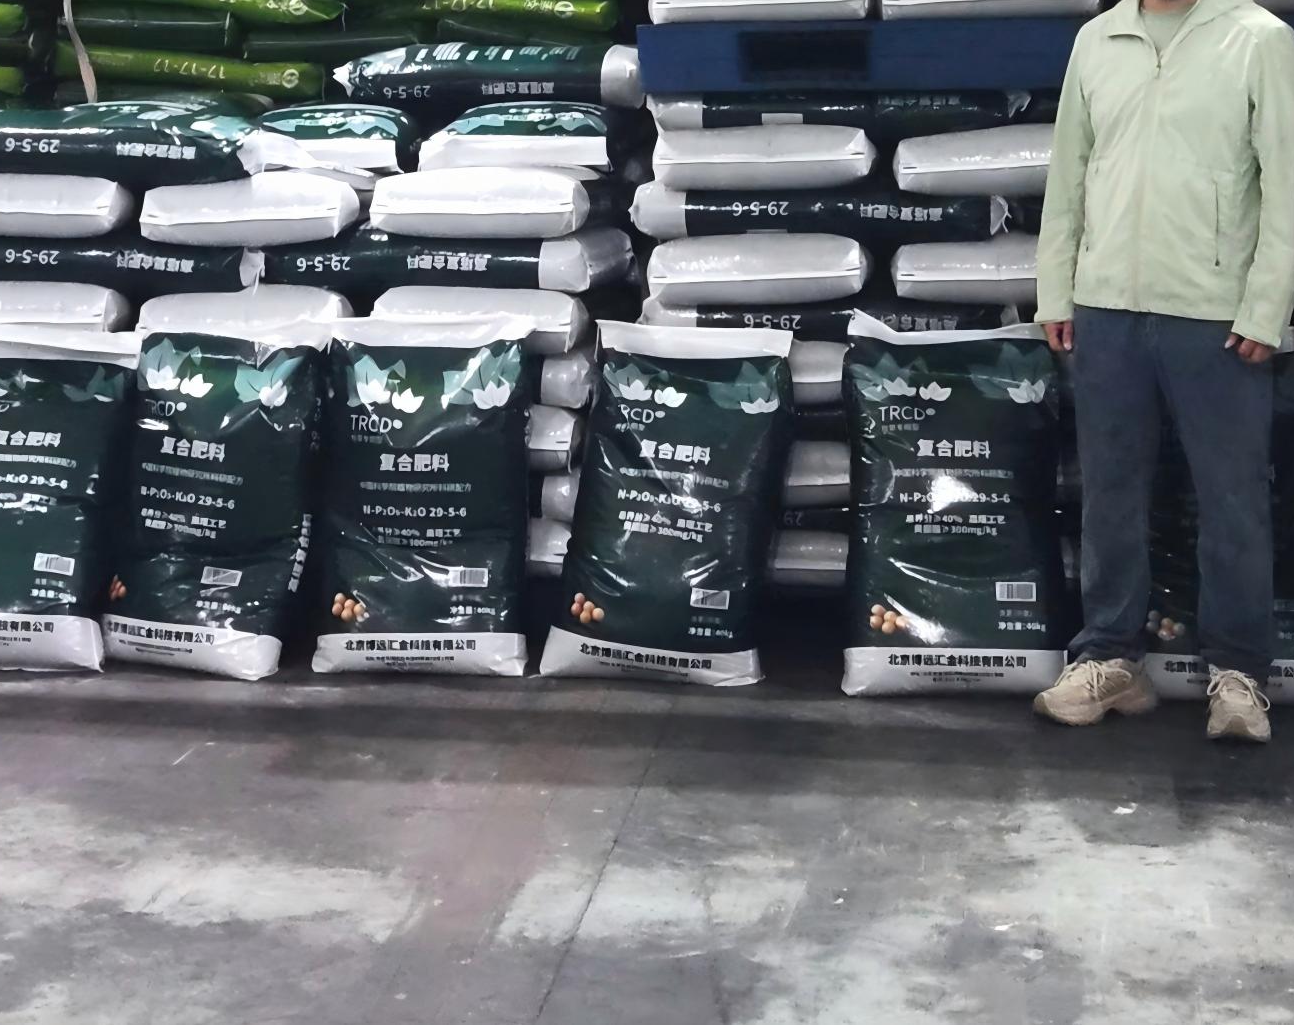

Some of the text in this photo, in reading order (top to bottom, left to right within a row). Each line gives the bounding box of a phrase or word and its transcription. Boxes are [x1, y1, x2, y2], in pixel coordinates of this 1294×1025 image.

[382, 83, 430, 99] 29-5-6
[4, 135, 60, 153] 29-5-6
[4, 249, 60, 265] 29-5-6
[296, 255, 352, 273] 29-5-6
[744, 313, 802, 329] 29-5-6
[916, 439, 990, 459] 复合肥料
[378, 453, 450, 473] 复合肥料
[196, 495, 236, 511] 29-5-6
